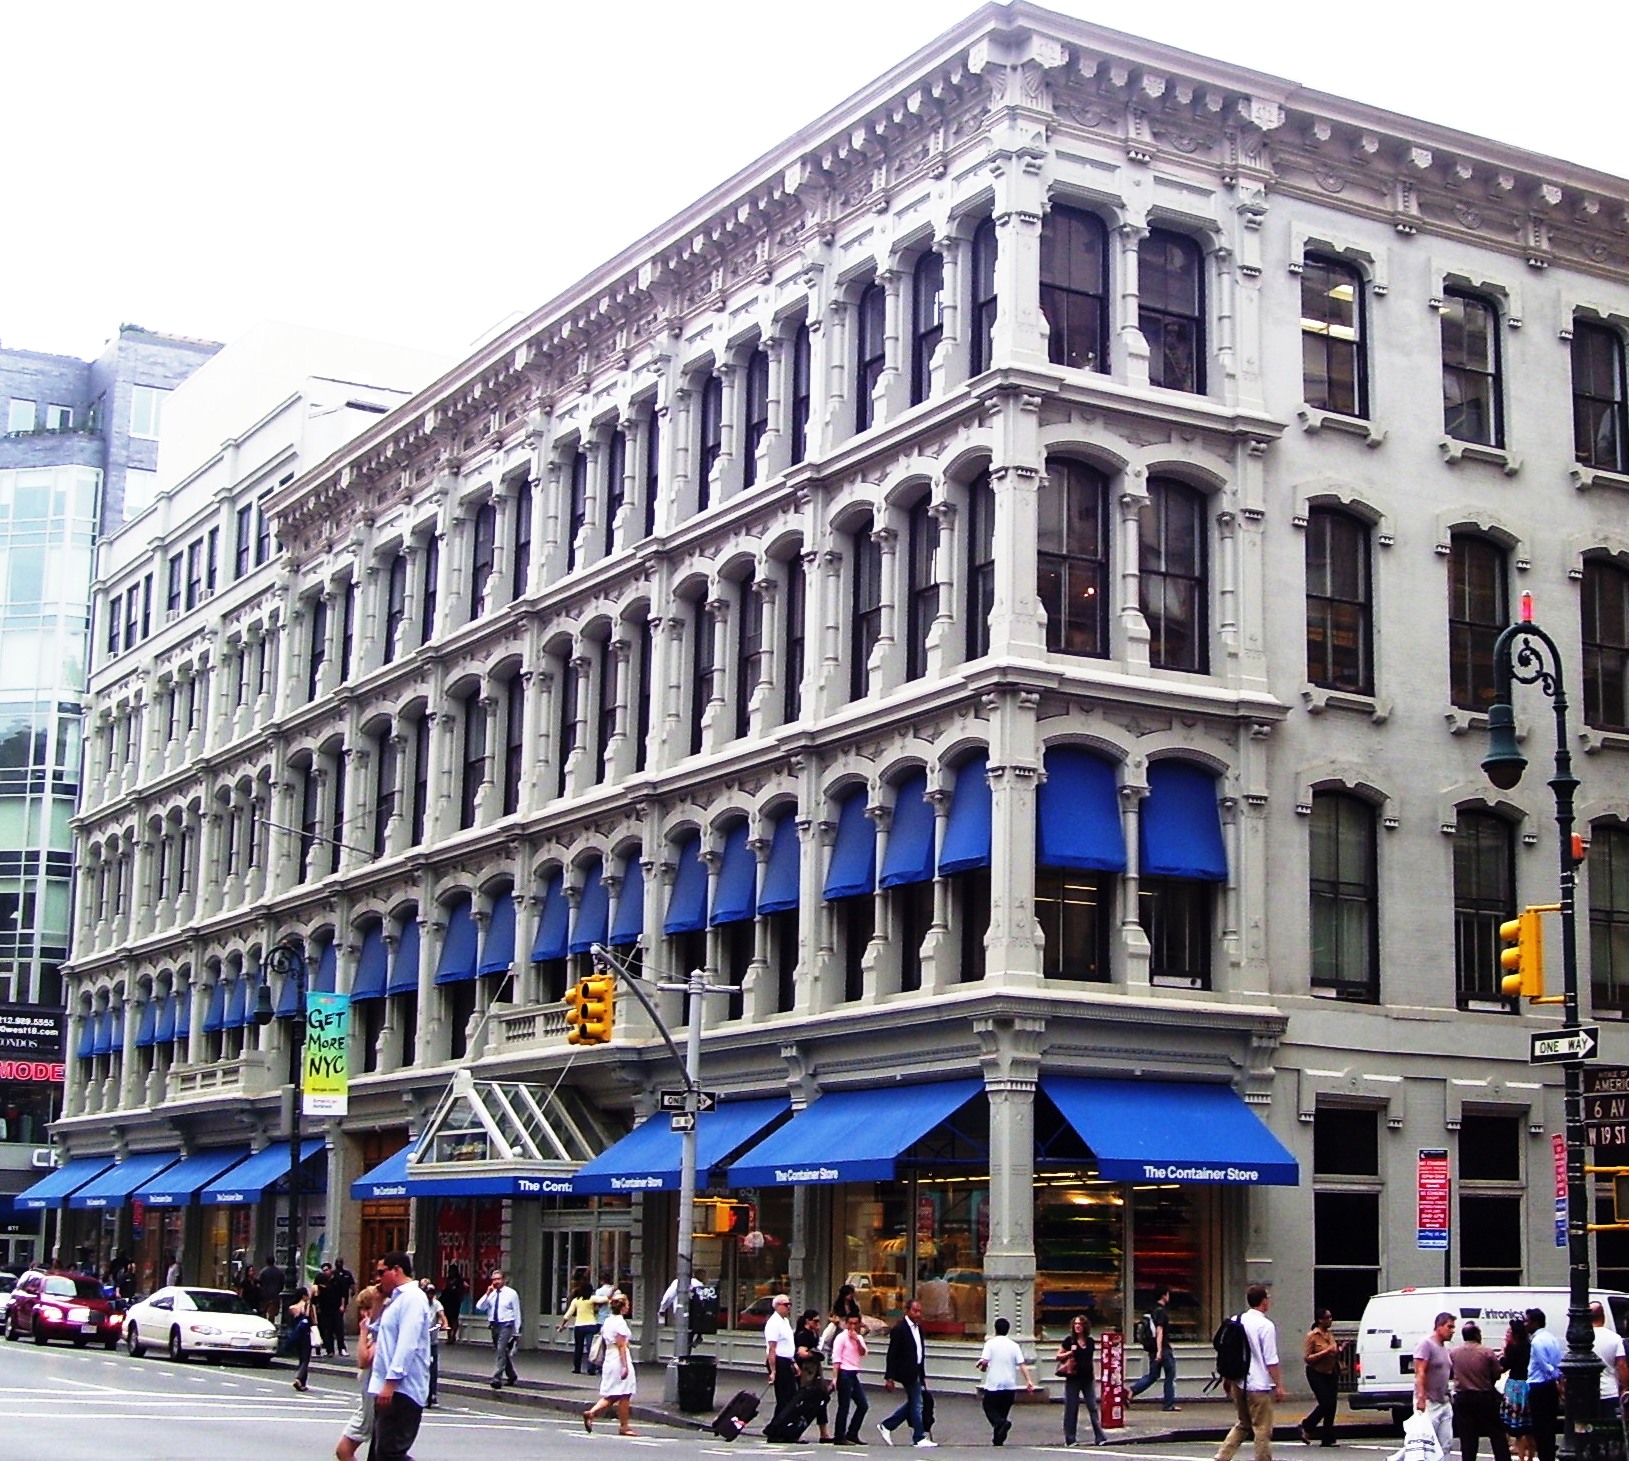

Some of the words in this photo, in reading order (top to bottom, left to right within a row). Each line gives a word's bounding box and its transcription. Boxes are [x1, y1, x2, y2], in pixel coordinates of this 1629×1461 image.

[308, 1008, 346, 1031] GET
[0, 1038, 38, 1048] ONDOS
[307, 1033, 345, 1052] MORE
[1540, 1040, 1560, 1054] ONE
[1568, 1038, 1589, 1051] WAY
[309, 1055, 345, 1078] NYC
[1593, 1100, 1602, 1118] 6
[1610, 1099, 1625, 1117] AV
[1588, 1127, 1597, 1145] W
[1601, 1126, 1611, 1145] 19
[1615, 1126, 1626, 1144] ST
[820, 1167, 839, 1180] Store
[1143, 1165, 1166, 1178] The
[1167, 1165, 1226, 1180] Container
[1227, 1167, 1259, 1181] Store
[518, 1180, 540, 1191] The
[611, 1178, 621, 1189] The
[621, 1177, 648, 1188] Container
[648, 1176, 663, 1188] Store
